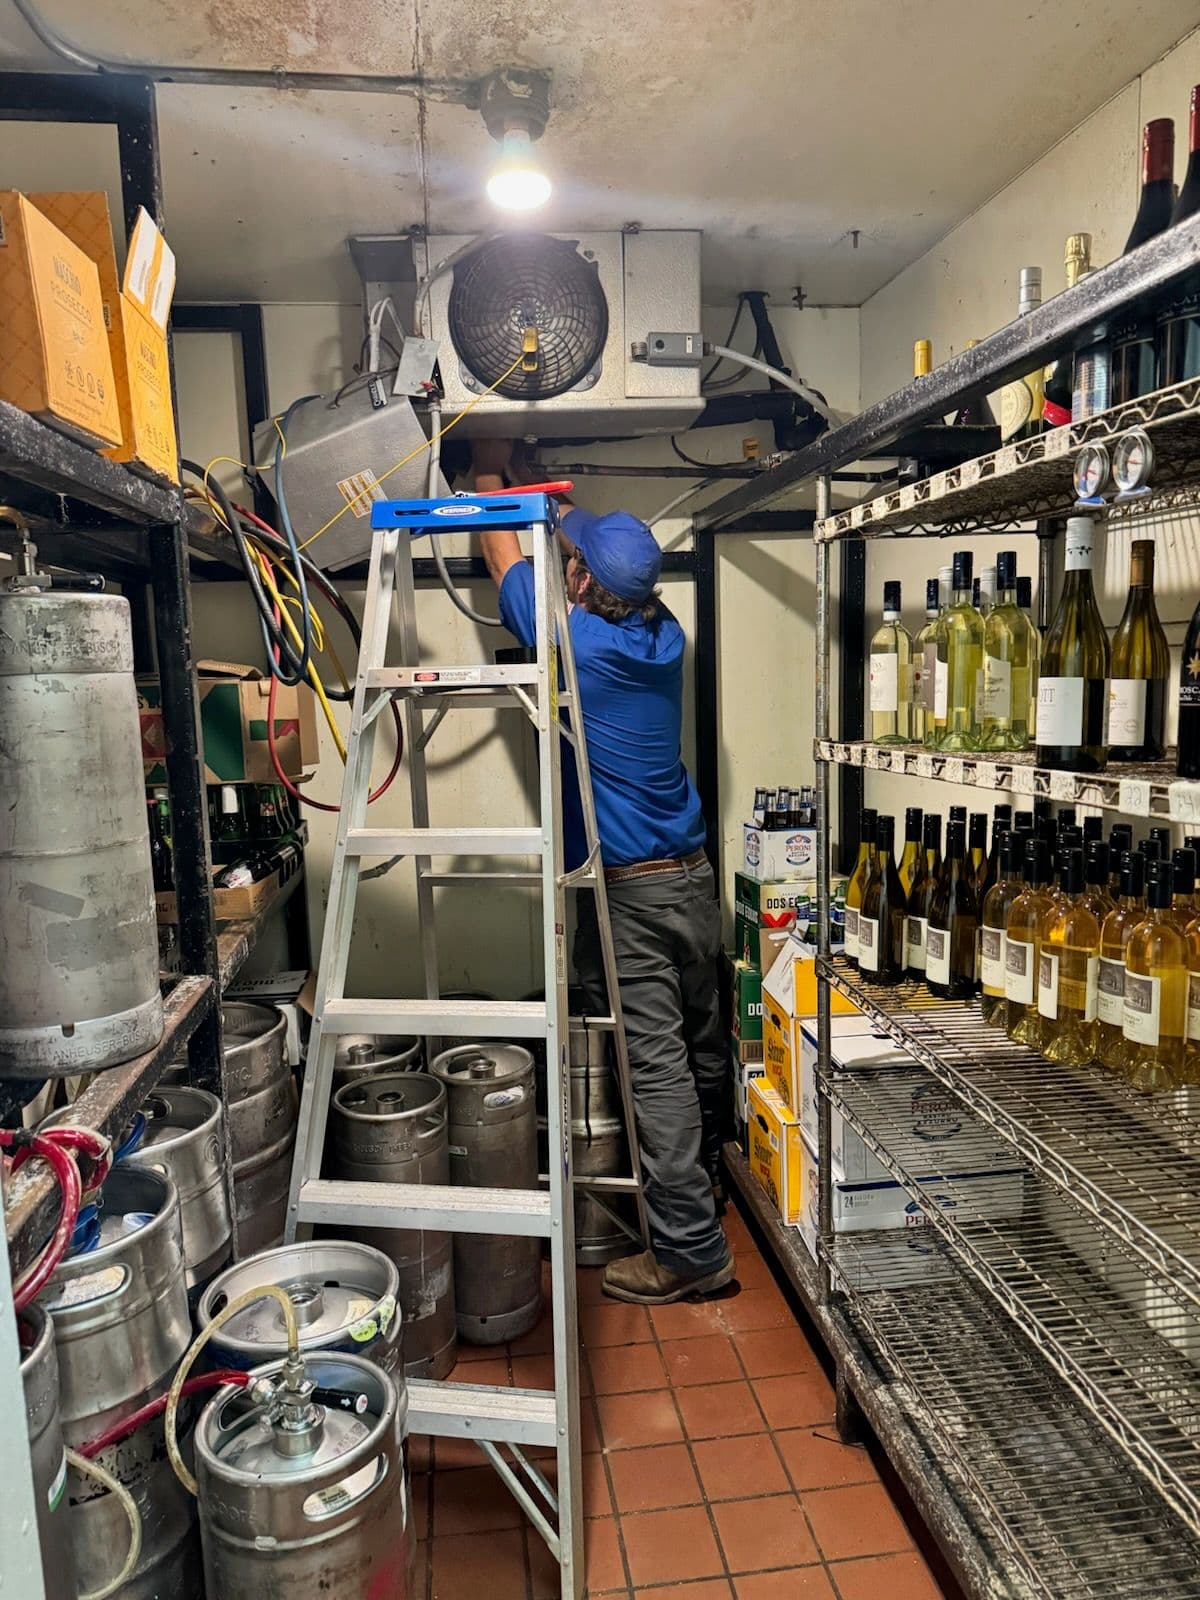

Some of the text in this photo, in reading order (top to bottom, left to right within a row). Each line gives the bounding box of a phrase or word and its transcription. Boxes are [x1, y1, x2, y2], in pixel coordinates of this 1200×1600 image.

[785, 844, 812, 852] PERONI
[766, 898, 786, 909] DOS
[844, 1196, 854, 1208] 24
